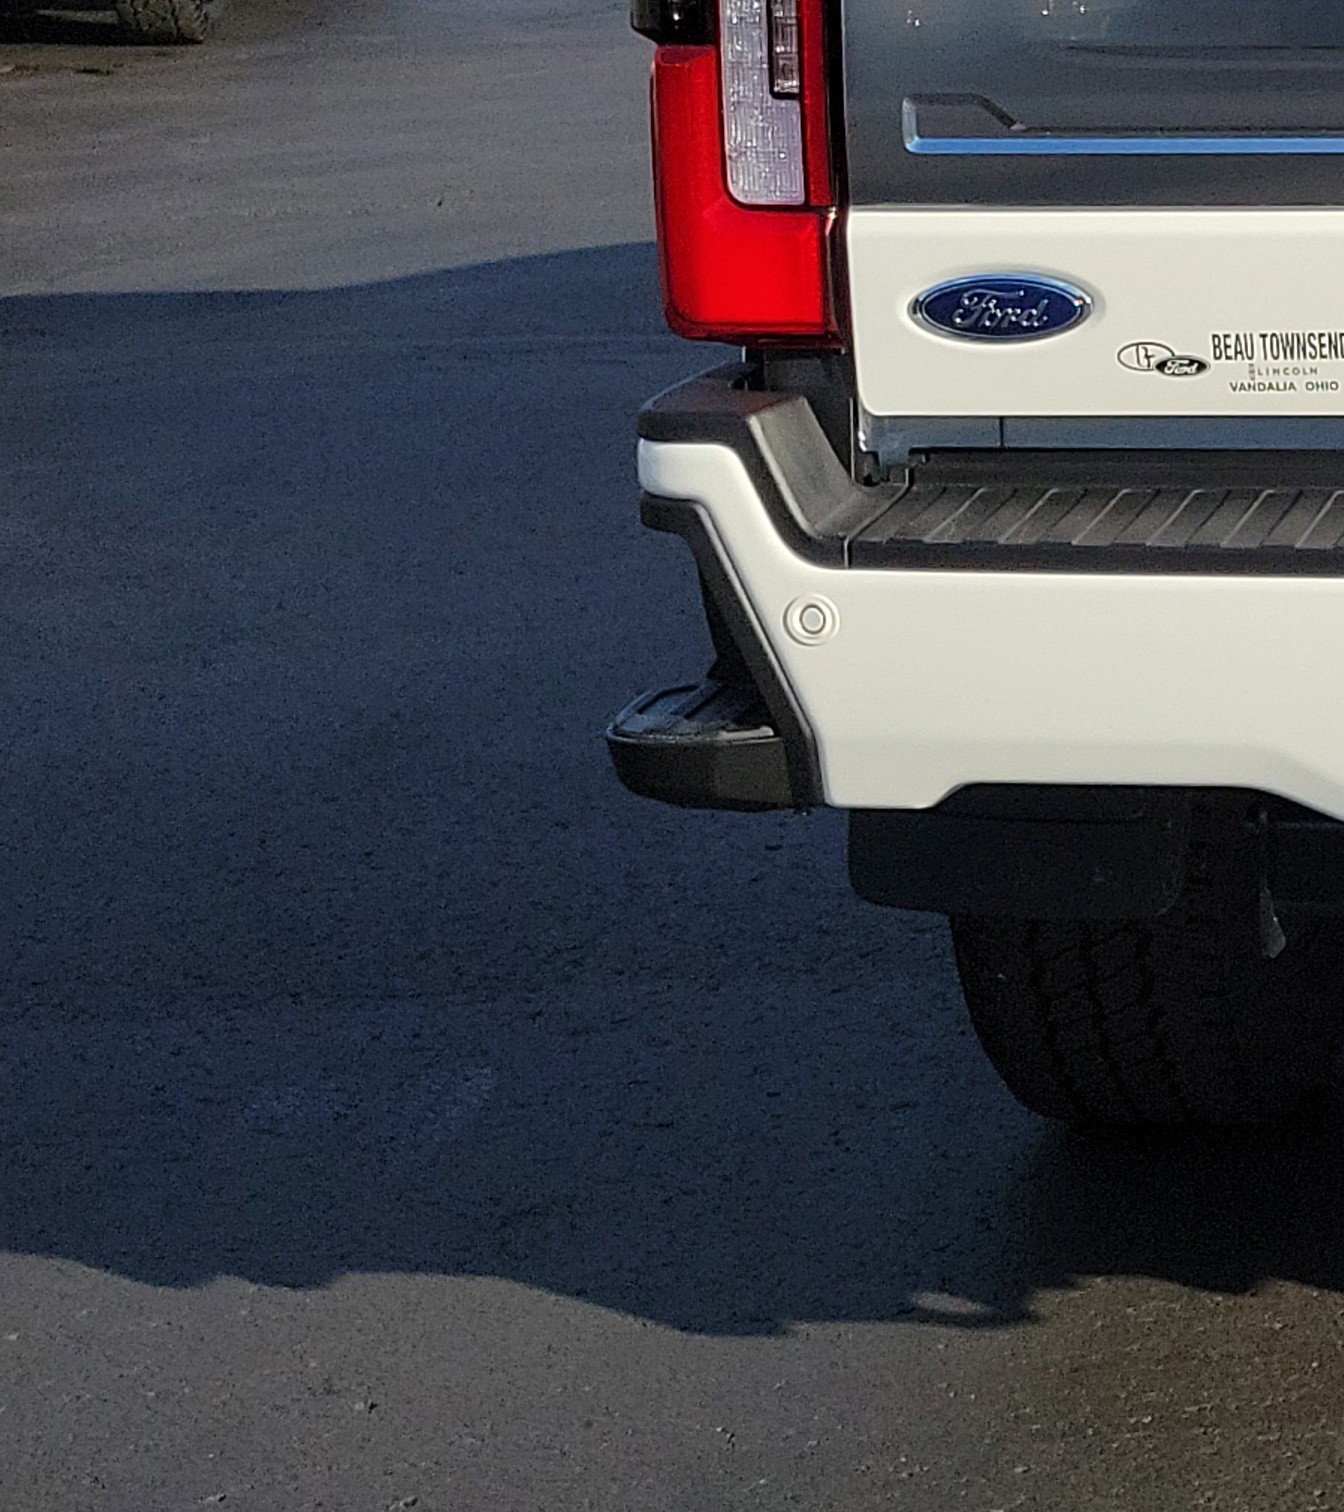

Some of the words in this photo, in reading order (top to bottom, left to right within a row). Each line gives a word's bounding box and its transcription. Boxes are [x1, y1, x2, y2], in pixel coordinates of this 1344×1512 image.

[951, 287, 1050, 331] Ford
[1211, 333, 1254, 361] BEAU
[1163, 359, 1199, 376] Ford
[1257, 366, 1319, 376] LINCOLN
[1229, 381, 1297, 393] VANDALIA
[1305, 381, 1340, 392] OHIO
